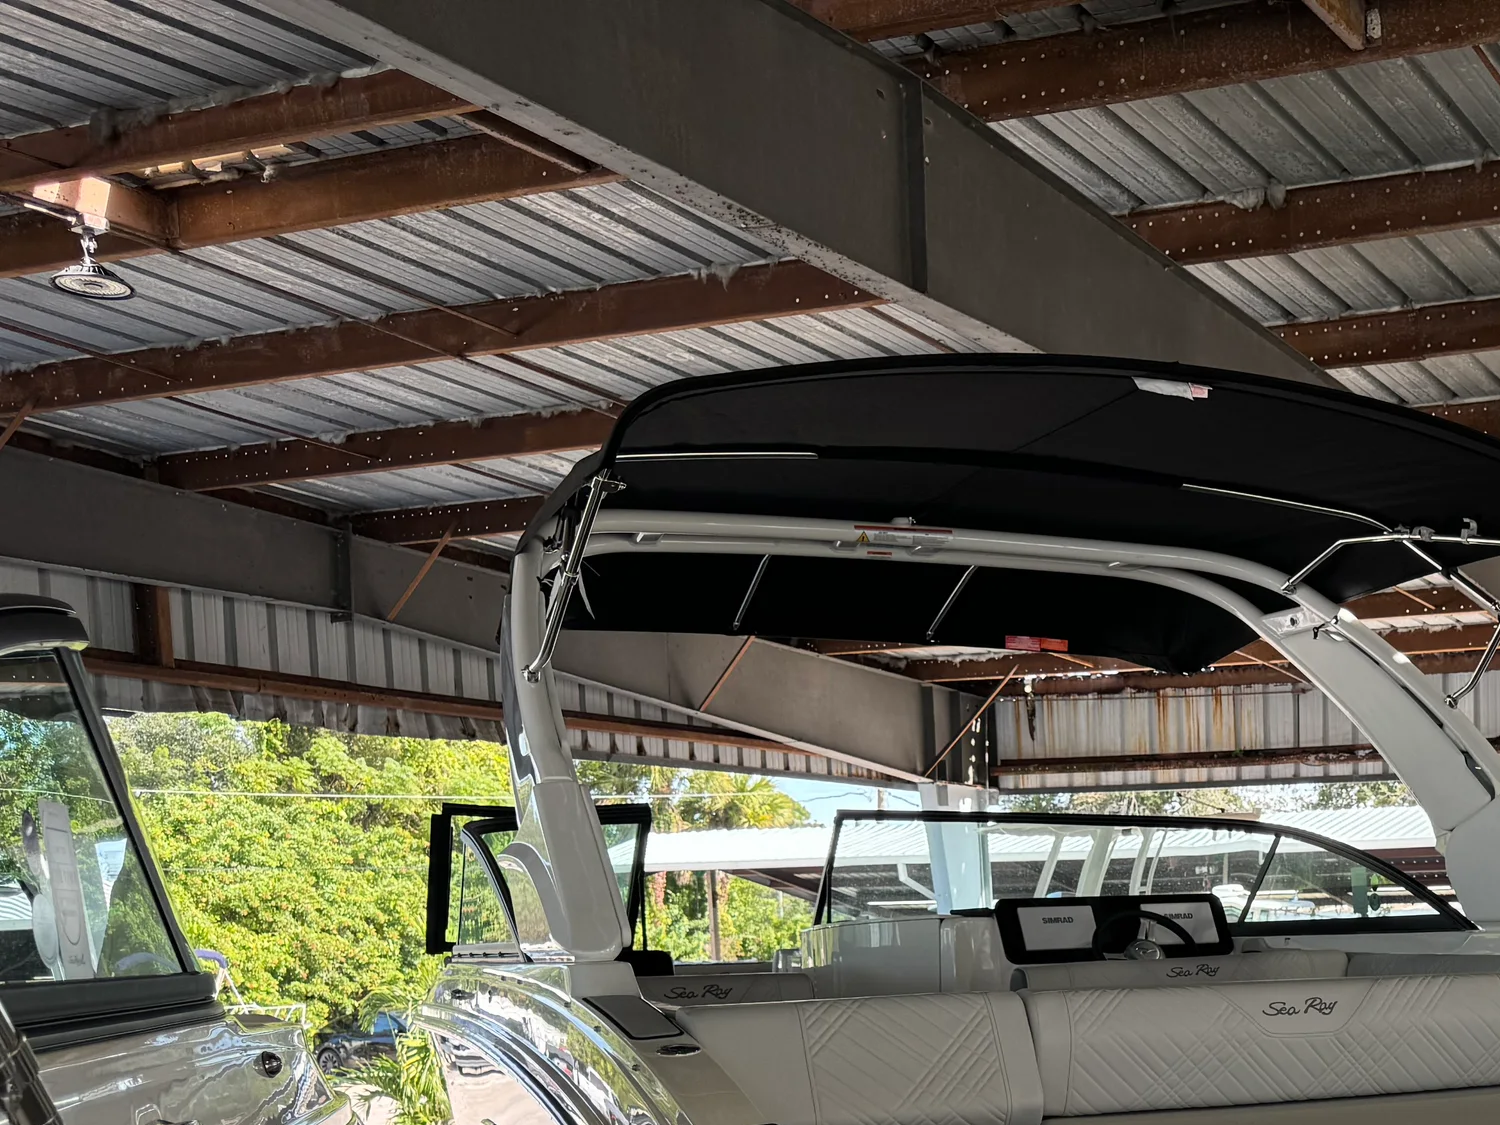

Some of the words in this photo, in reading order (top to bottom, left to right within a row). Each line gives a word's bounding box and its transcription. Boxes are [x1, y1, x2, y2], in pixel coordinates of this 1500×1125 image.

[1041, 916, 1074, 924] SIMRAD
[1166, 966, 1193, 978] Sea
[1195, 963, 1220, 977] Ray
[663, 986, 698, 1000] Sea
[701, 984, 733, 1000] Ray
[1262, 1001, 1301, 1017] Sea
[1303, 996, 1338, 1016] Ray
